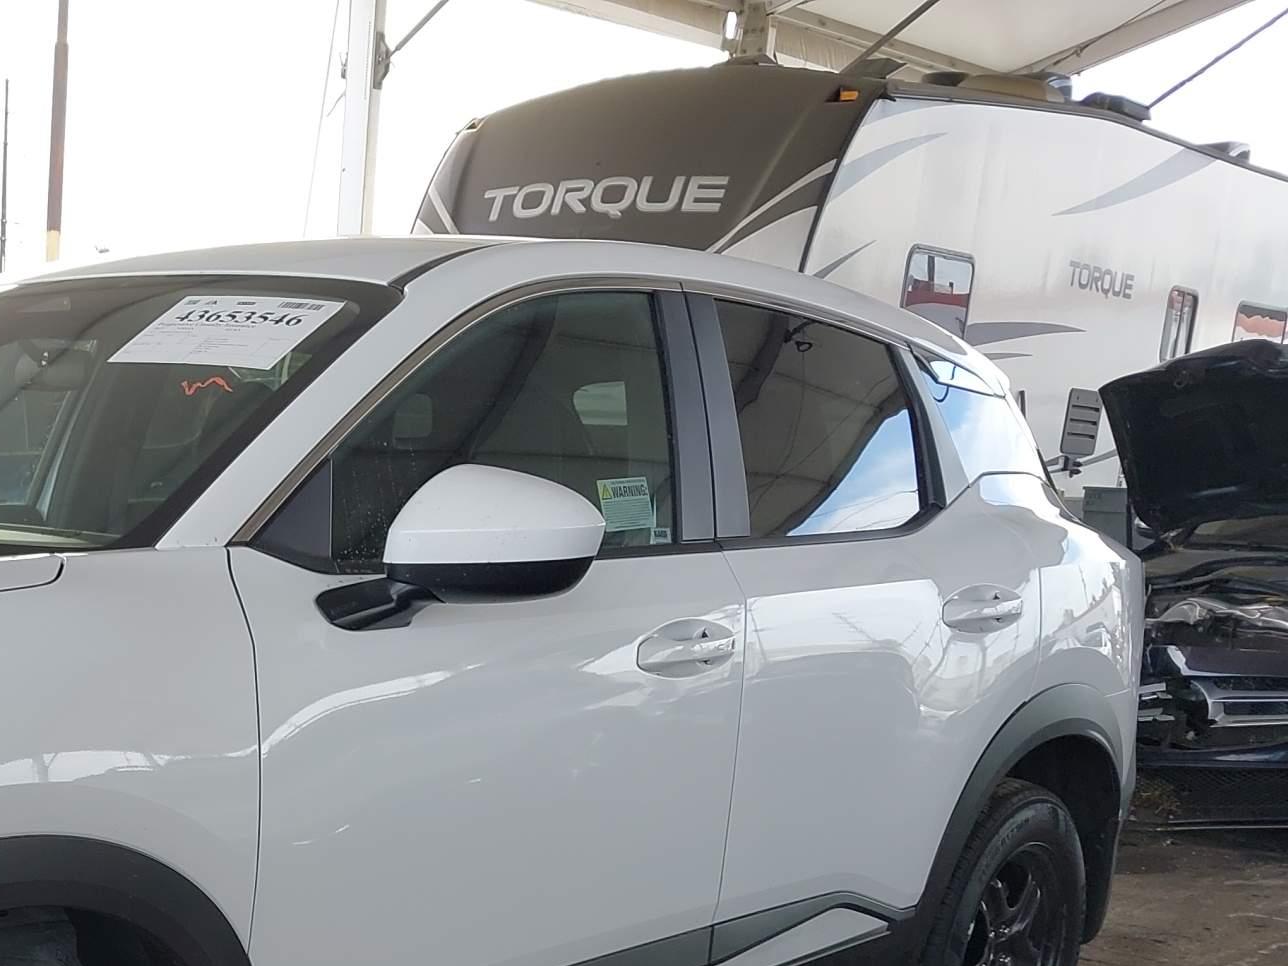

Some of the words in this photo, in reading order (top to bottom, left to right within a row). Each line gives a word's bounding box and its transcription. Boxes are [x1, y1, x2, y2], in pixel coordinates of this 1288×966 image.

[484, 175, 730, 222] TORQUE
[1069, 260, 1135, 299] TORQUE
[175, 309, 309, 326] 43653546
